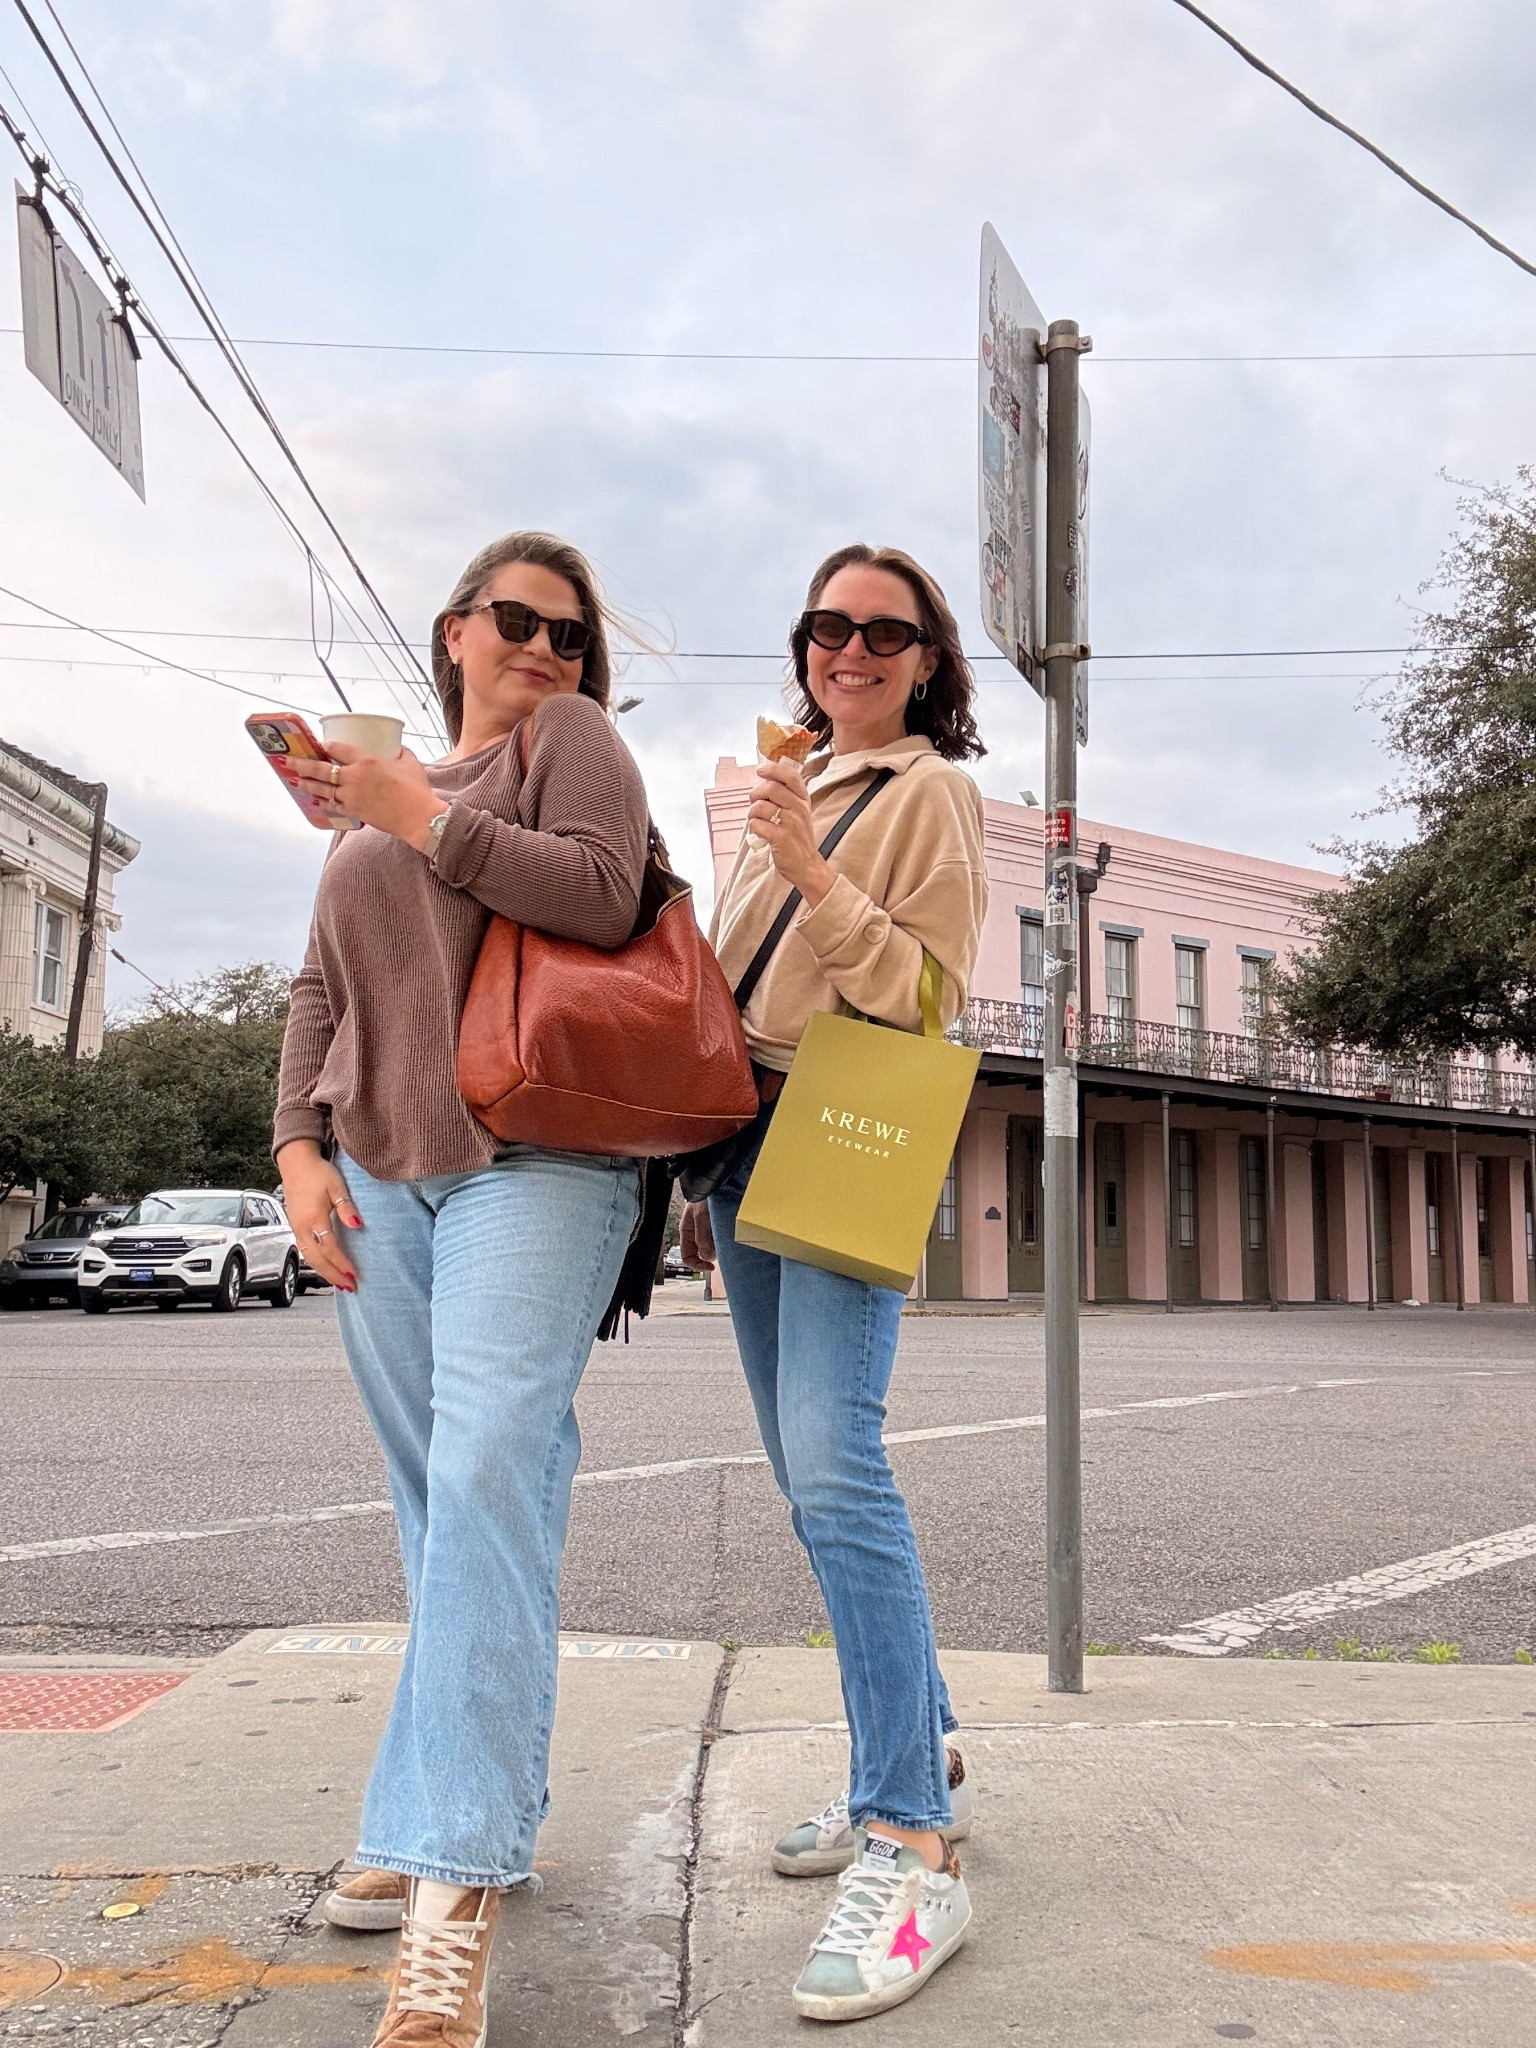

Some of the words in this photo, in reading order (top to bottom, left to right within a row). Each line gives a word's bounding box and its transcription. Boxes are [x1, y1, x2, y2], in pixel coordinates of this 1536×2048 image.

[65, 372, 91, 422] ONLY
[96, 408, 118, 453] ONLY
[819, 1106, 911, 1146] KREWE
[827, 1135, 890, 1159] EYEWEAR
[869, 1841, 896, 1857] GGDB
